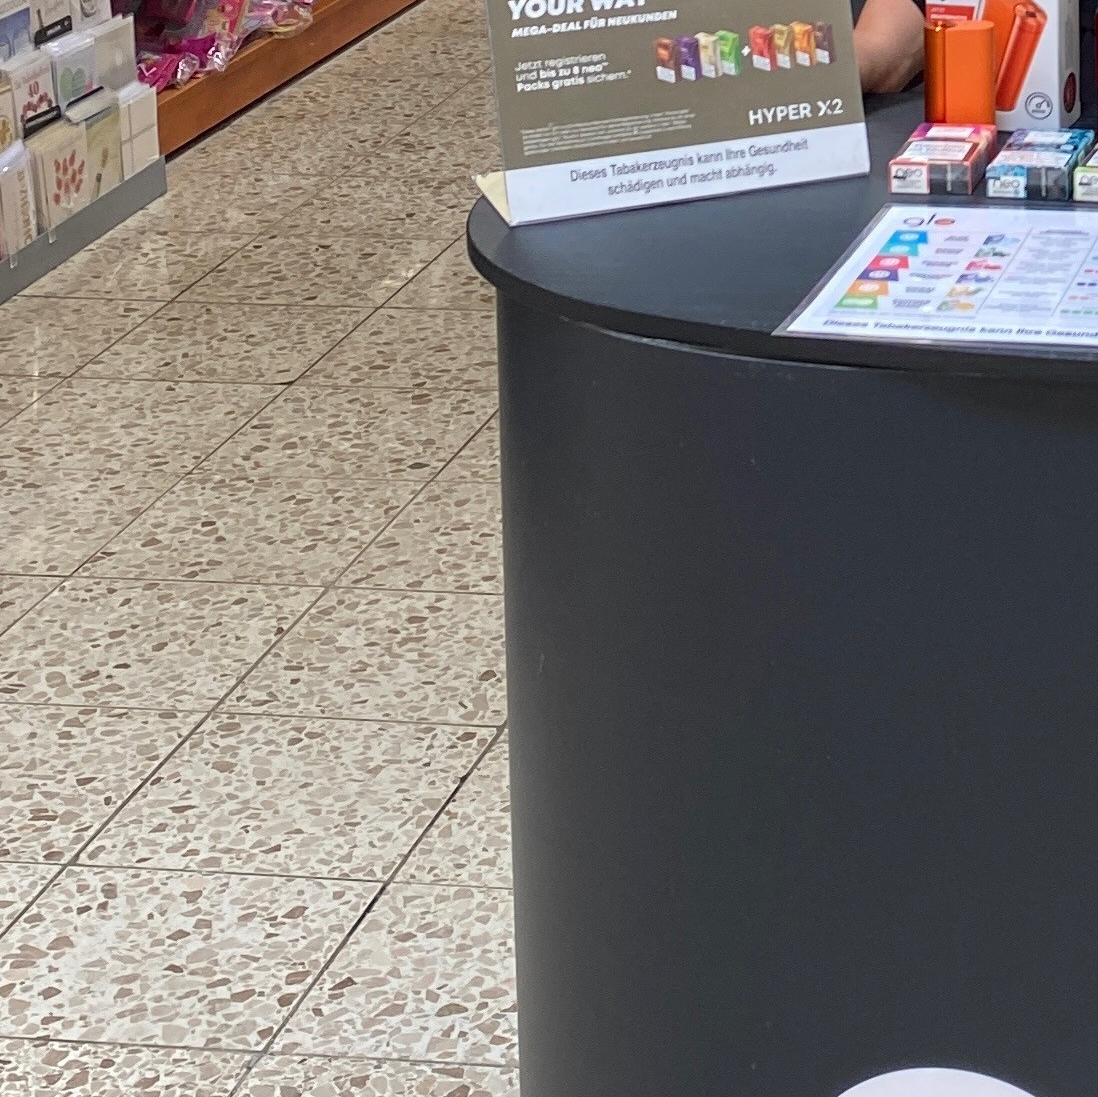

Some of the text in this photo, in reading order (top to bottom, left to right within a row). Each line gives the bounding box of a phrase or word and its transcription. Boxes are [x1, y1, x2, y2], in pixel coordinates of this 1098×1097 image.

[510, 10, 678, 38] MEGA-DEAL FÜR NEUKUNDEN
[514, 52, 607, 72] Jetzt registrieren
[516, 70, 537, 82] und
[540, 67, 556, 79] bis
[558, 68, 571, 76] zu
[517, 79, 550, 93] Packs
[552, 76, 584, 90] gratis
[748, 98, 844, 126] HYPER X2
[569, 138, 809, 184] Dieses Tabakerzeugnis kann Ihre Gesundheit
[607, 163, 777, 198] schädigen und macht abhängig.
[903, 213, 956, 228] glo
